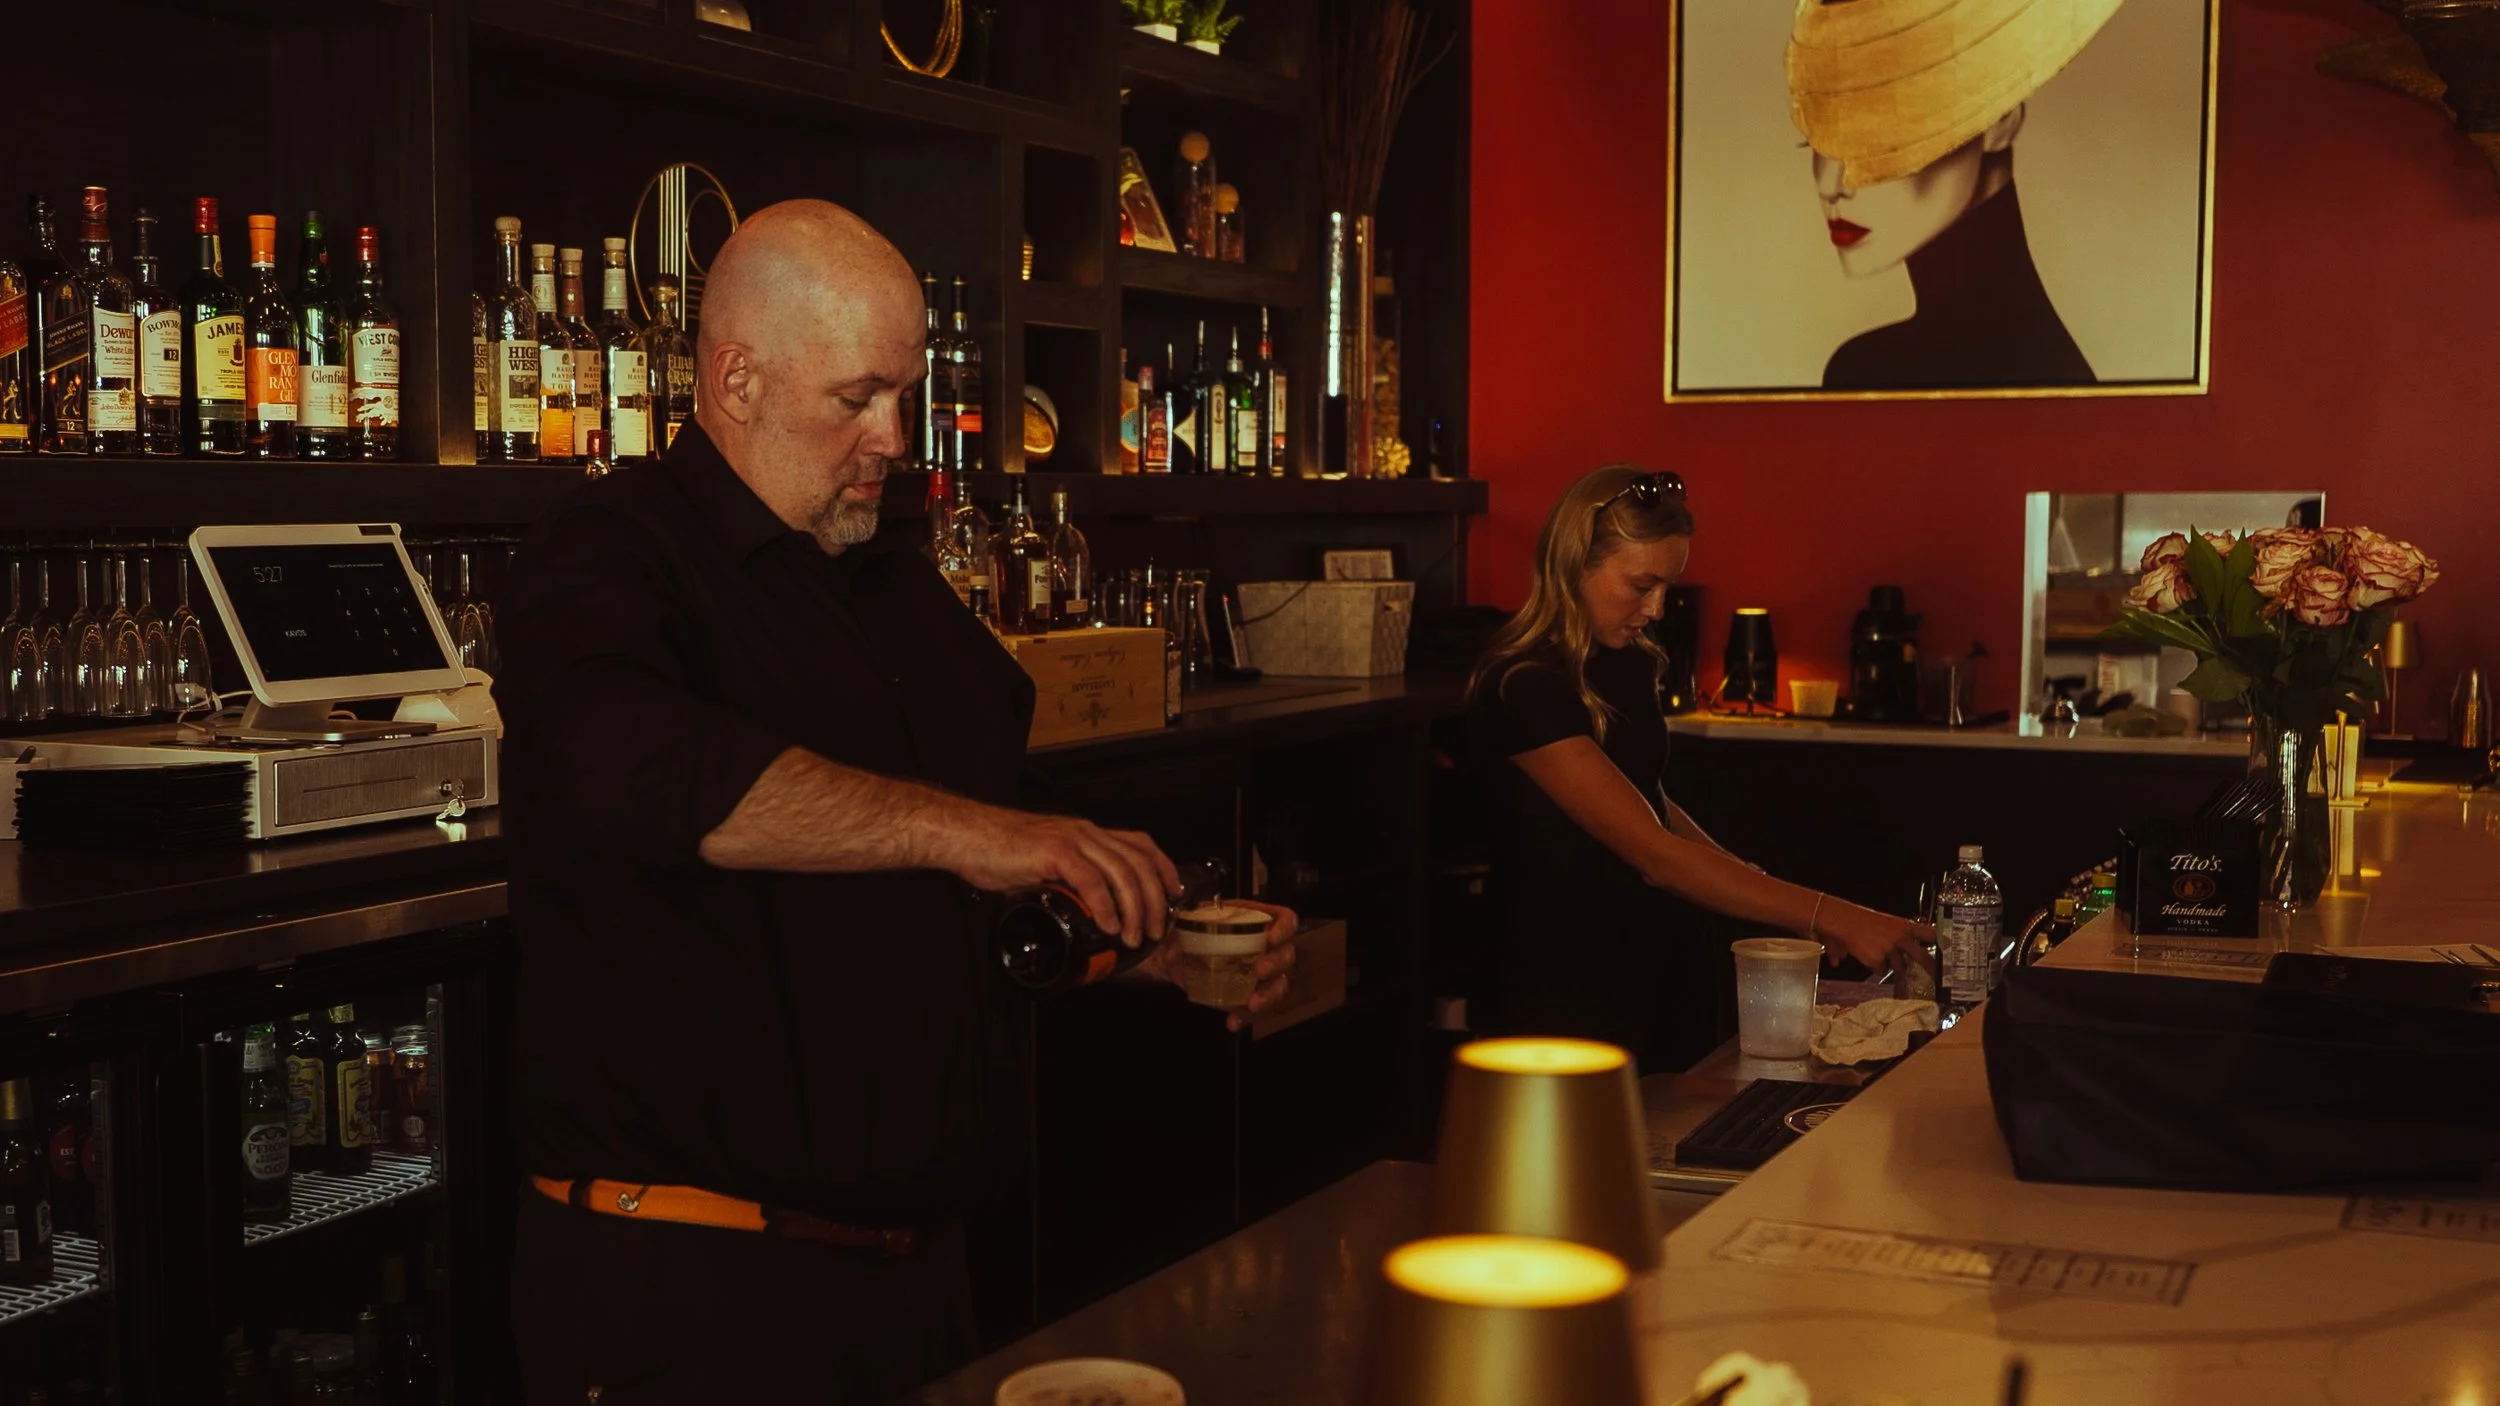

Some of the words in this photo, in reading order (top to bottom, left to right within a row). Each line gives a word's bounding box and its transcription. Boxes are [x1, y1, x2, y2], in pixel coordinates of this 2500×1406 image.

[359, 333, 386, 346] WEST
[168, 350, 177, 360] 12
[268, 351, 297, 365] GLEN
[280, 365, 298, 378] MO
[269, 377, 293, 389] RAN
[66, 421, 76, 431] 12
[253, 565, 283, 583] 5:27
[2169, 852, 2222, 872] Tito's
[2161, 901, 2227, 917] Handmade
[2176, 918, 2210, 926] VODKA
